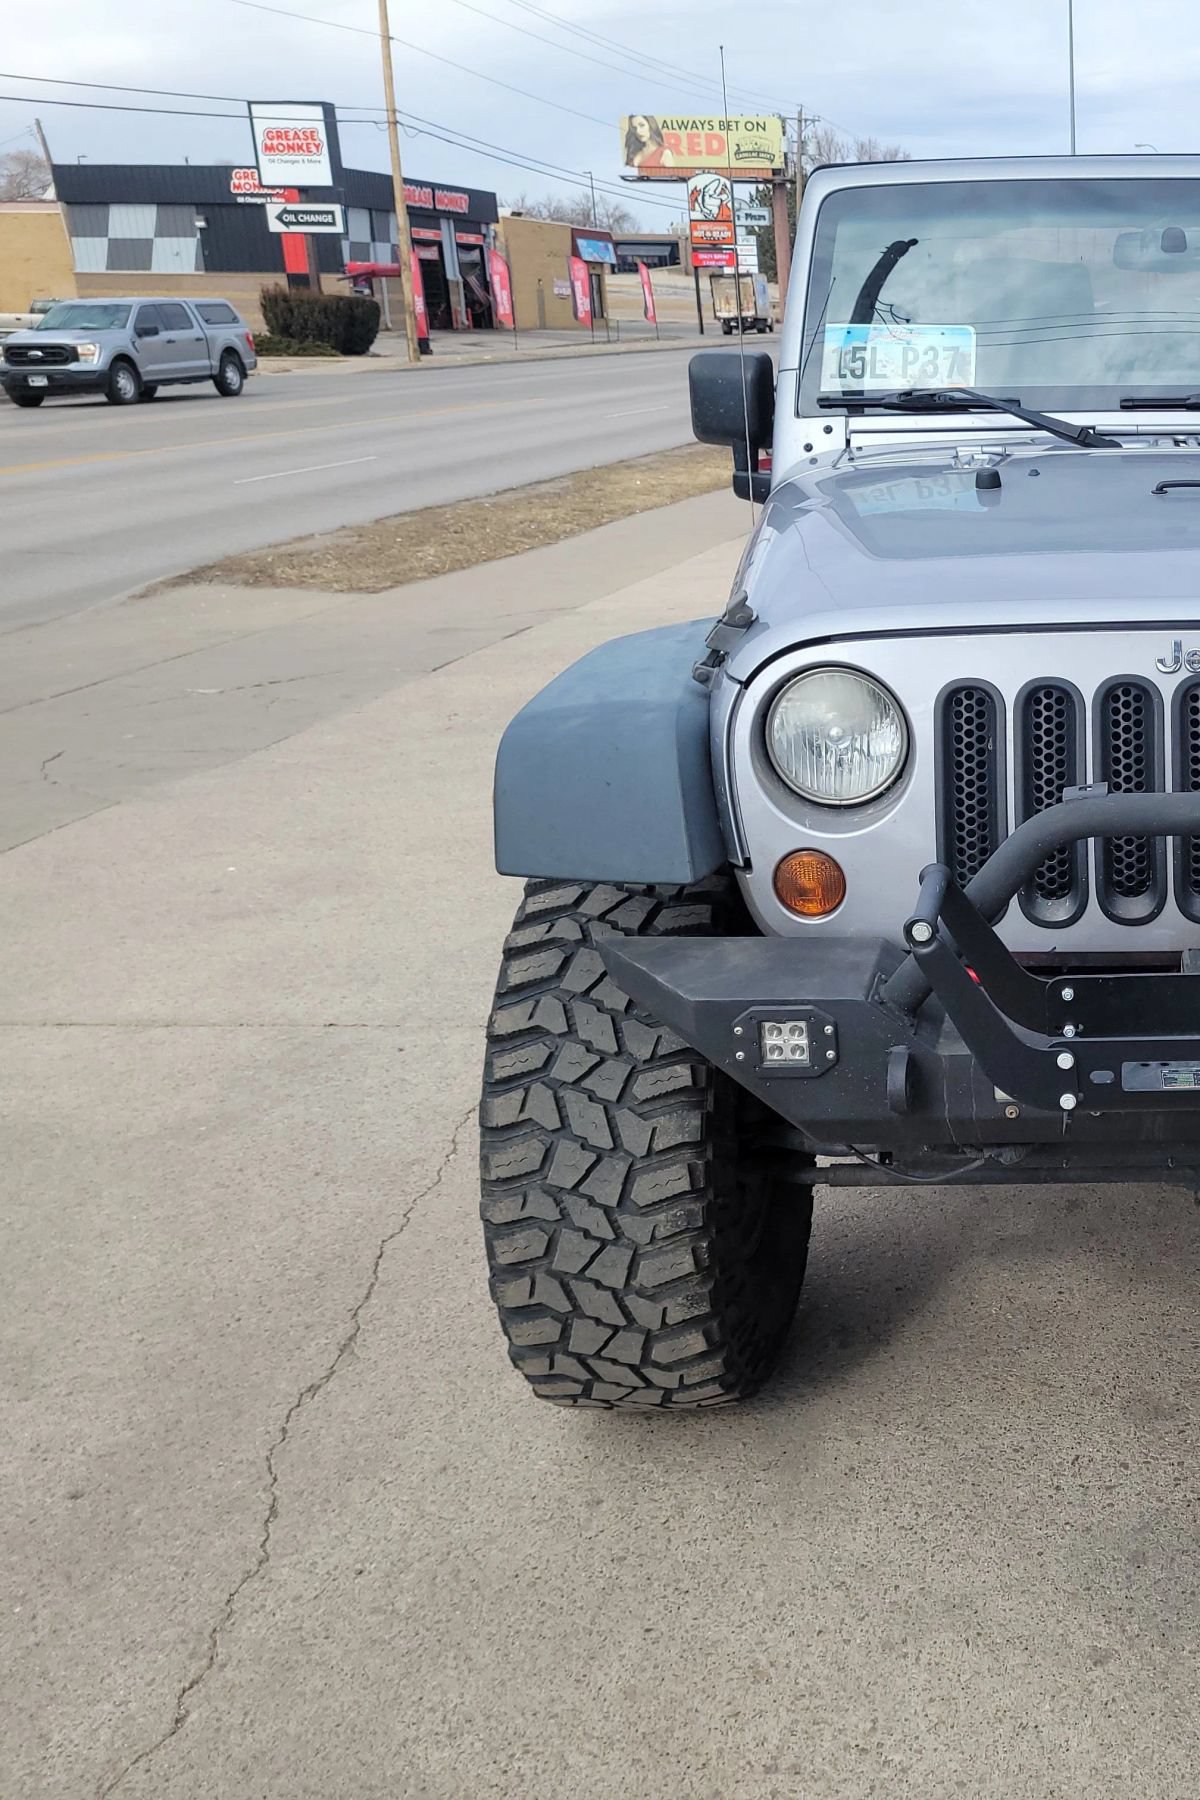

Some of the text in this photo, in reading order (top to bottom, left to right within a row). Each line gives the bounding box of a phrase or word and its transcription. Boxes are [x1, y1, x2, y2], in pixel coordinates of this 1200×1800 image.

[661, 119, 766, 132] ALWAYS BET ON
[265, 129, 318, 141] GREASE
[263, 142, 322, 154] MONKEY
[664, 132, 726, 157] RED
[233, 170, 257, 181] GRE
[282, 213, 333, 223] OIL CHANGE
[829, 345, 960, 379] 15L P37
